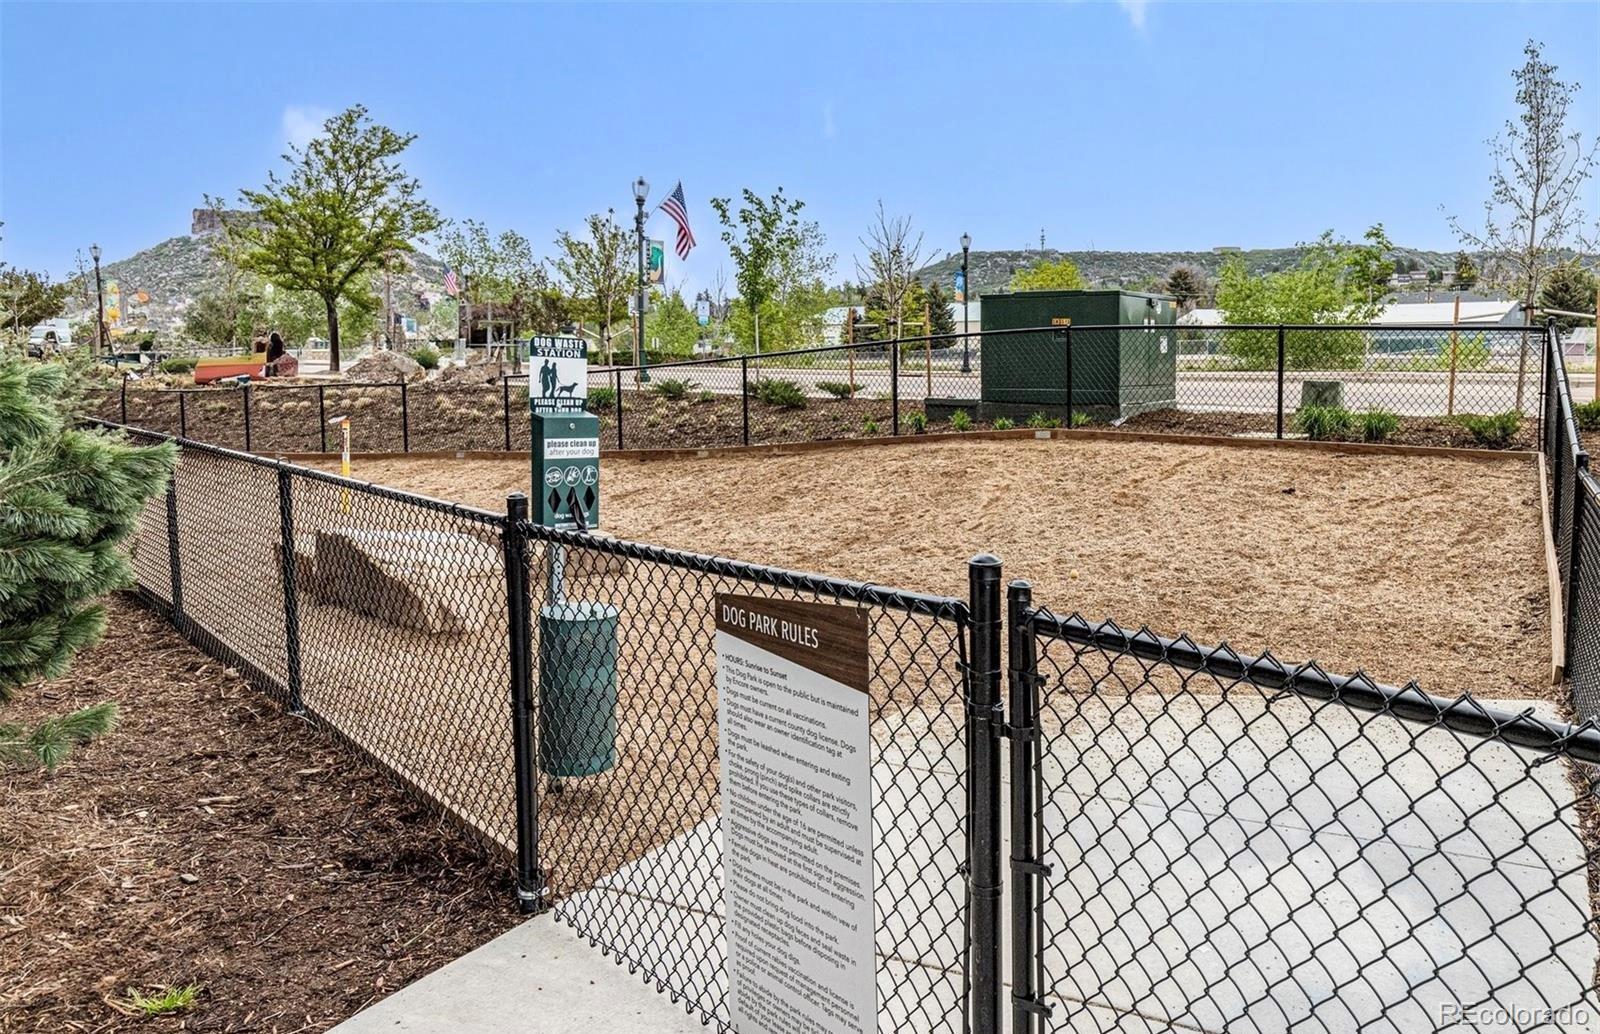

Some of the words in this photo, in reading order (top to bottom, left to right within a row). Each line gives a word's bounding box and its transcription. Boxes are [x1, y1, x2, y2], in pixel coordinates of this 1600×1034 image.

[534, 337, 552, 346] DOG
[555, 338, 584, 349] WASTE
[537, 348, 581, 358] STATION
[547, 440, 568, 448] please
[722, 605, 746, 628] DOG
[750, 612, 778, 638] PARK
[782, 620, 819, 649] RULES
